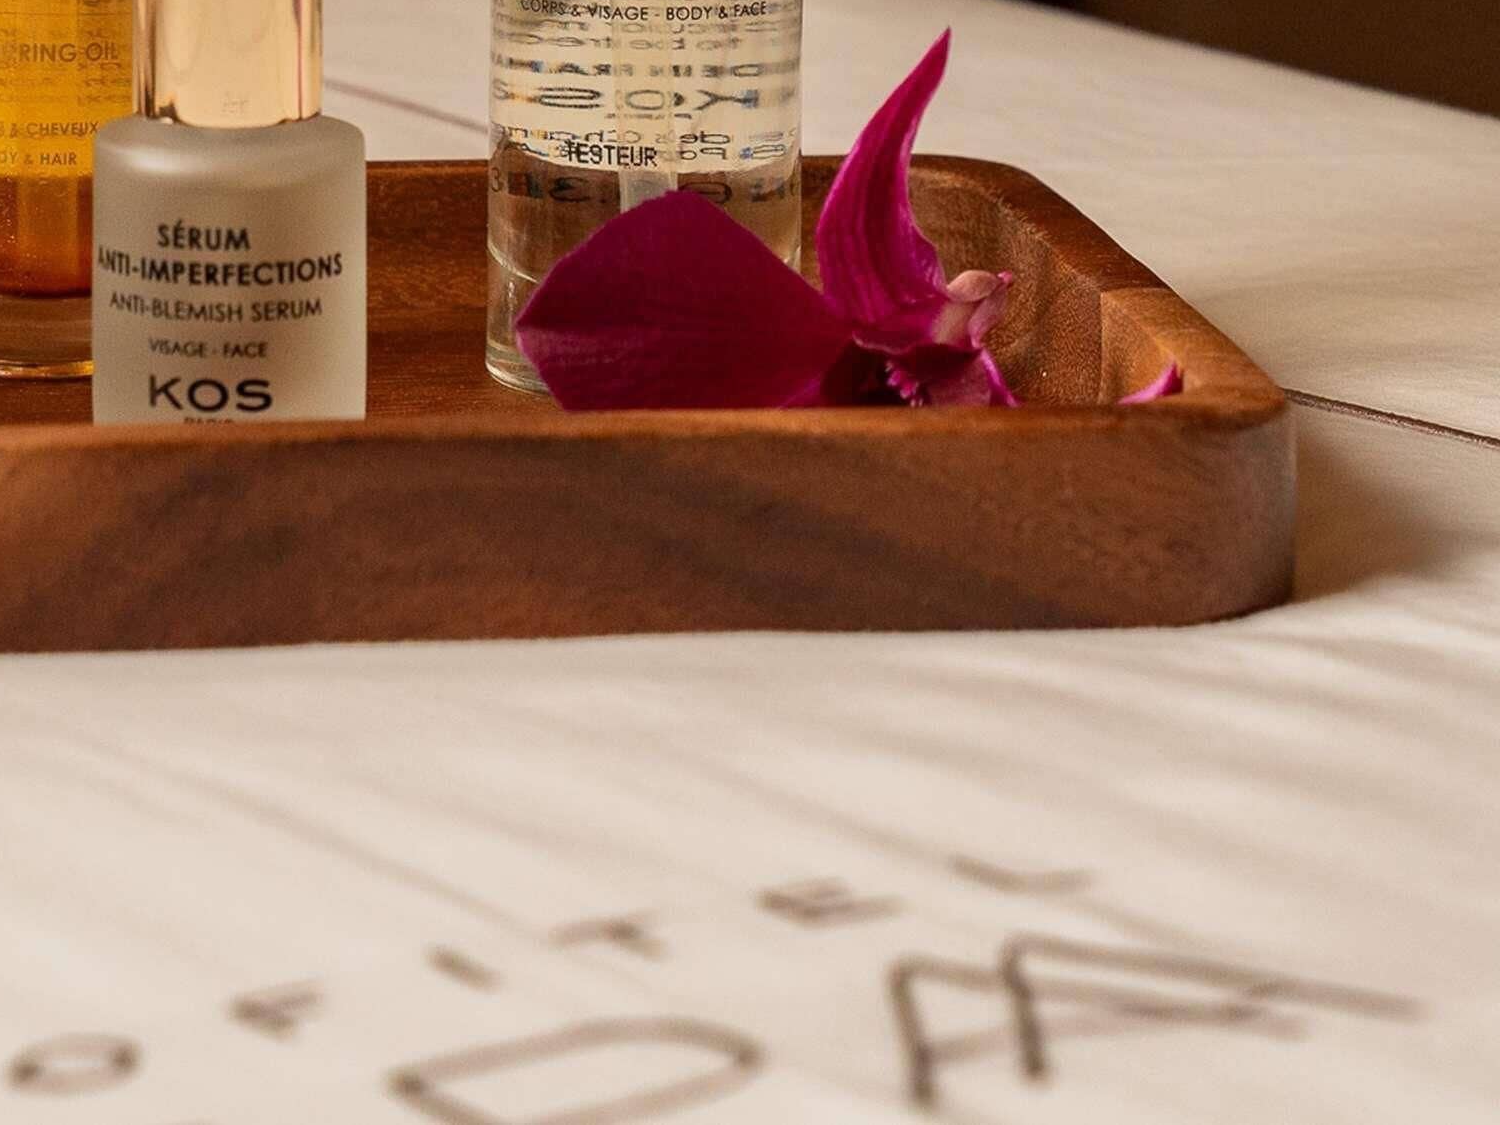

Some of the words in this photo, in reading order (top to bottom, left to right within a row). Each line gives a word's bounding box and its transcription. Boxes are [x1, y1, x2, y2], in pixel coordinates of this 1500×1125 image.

[585, 3, 649, 21] VISAGE
[665, 3, 713, 21] BODY
[733, 1, 768, 18] FACE
[85, 40, 120, 62] OIL
[39, 151, 78, 166] HAIR
[565, 142, 658, 167] TESTEUR
[157, 219, 251, 251] SÉRUM
[97, 246, 343, 287] ANTI-IMPERFECTIONS
[109, 291, 243, 322] ANTI-BLEMISH
[250, 298, 323, 322] SERUM
[149, 338, 208, 359] VISAGE
[222, 340, 269, 359] FACE
[149, 374, 273, 413] KOS
